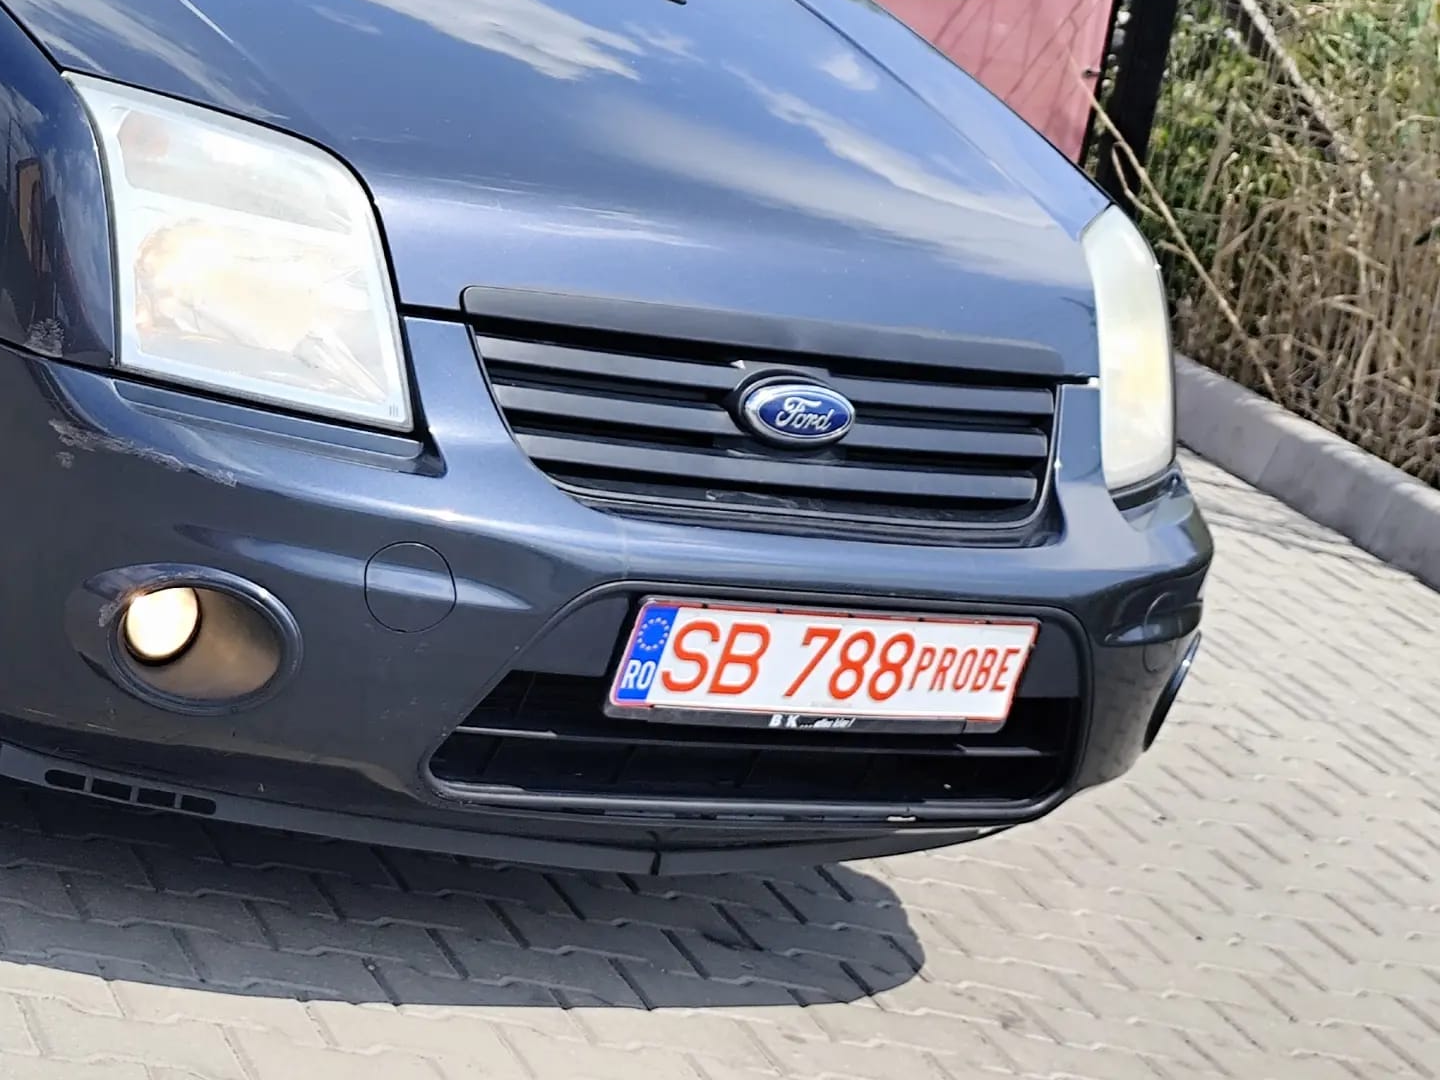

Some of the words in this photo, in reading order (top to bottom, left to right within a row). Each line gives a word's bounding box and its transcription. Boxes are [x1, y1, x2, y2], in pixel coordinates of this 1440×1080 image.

[774, 396, 835, 431] Ford
[622, 659, 657, 691] RO
[660, 619, 772, 695] SB
[783, 627, 916, 702] 788
[908, 645, 1021, 693] PROBE
